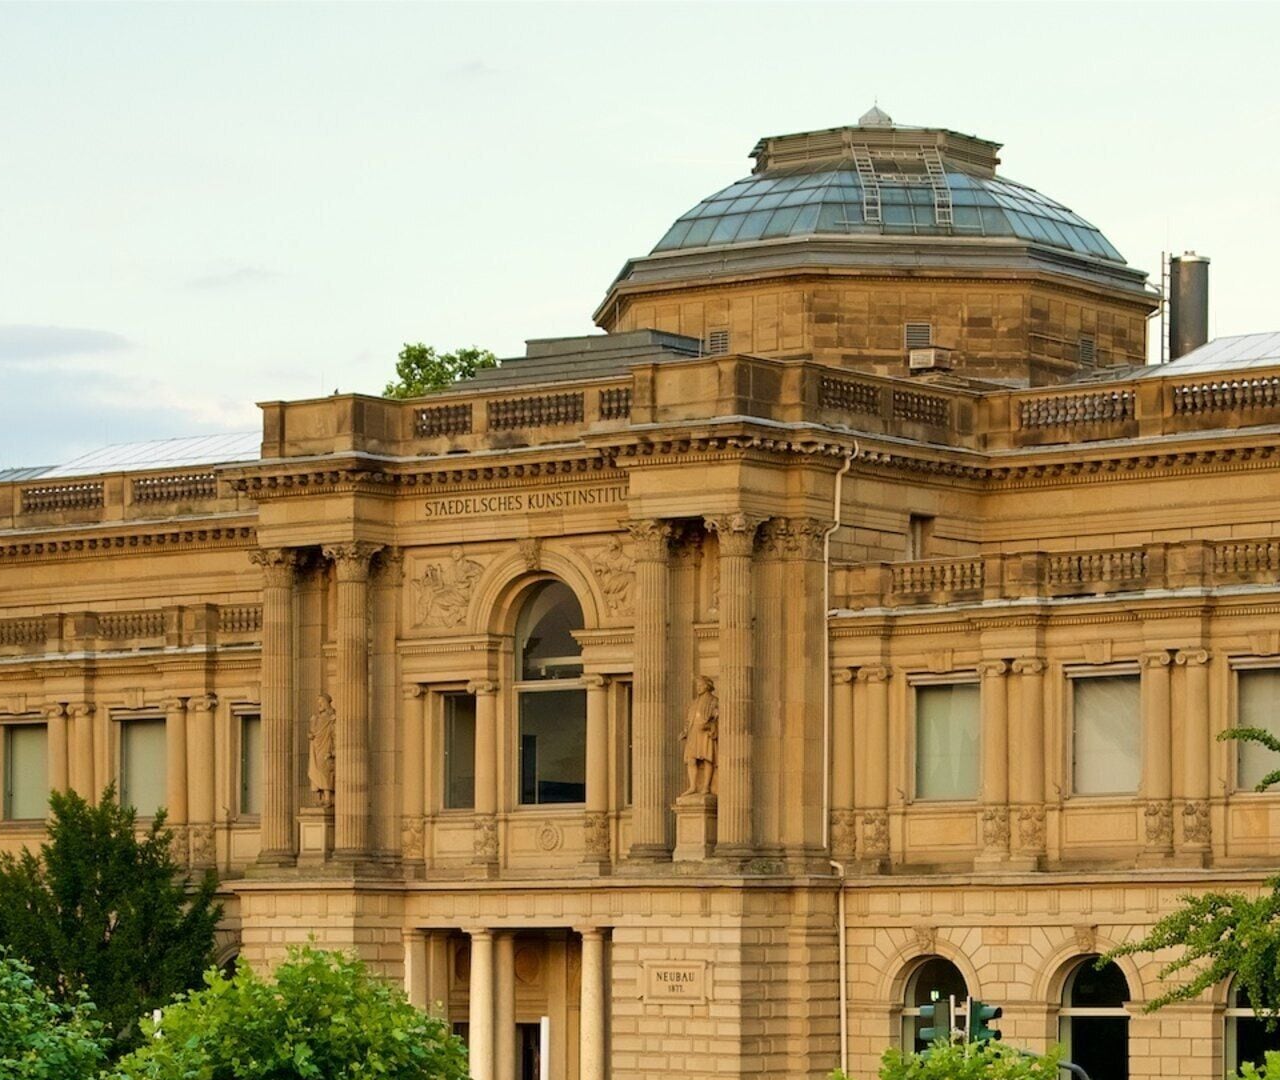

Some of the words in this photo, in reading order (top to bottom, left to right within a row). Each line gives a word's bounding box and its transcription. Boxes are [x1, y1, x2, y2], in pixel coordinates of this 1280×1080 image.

[425, 495, 523, 516] STAEDELSCHES
[528, 486, 630, 510] KUNSTINSTITU
[656, 971, 695, 982] NEUBAU
